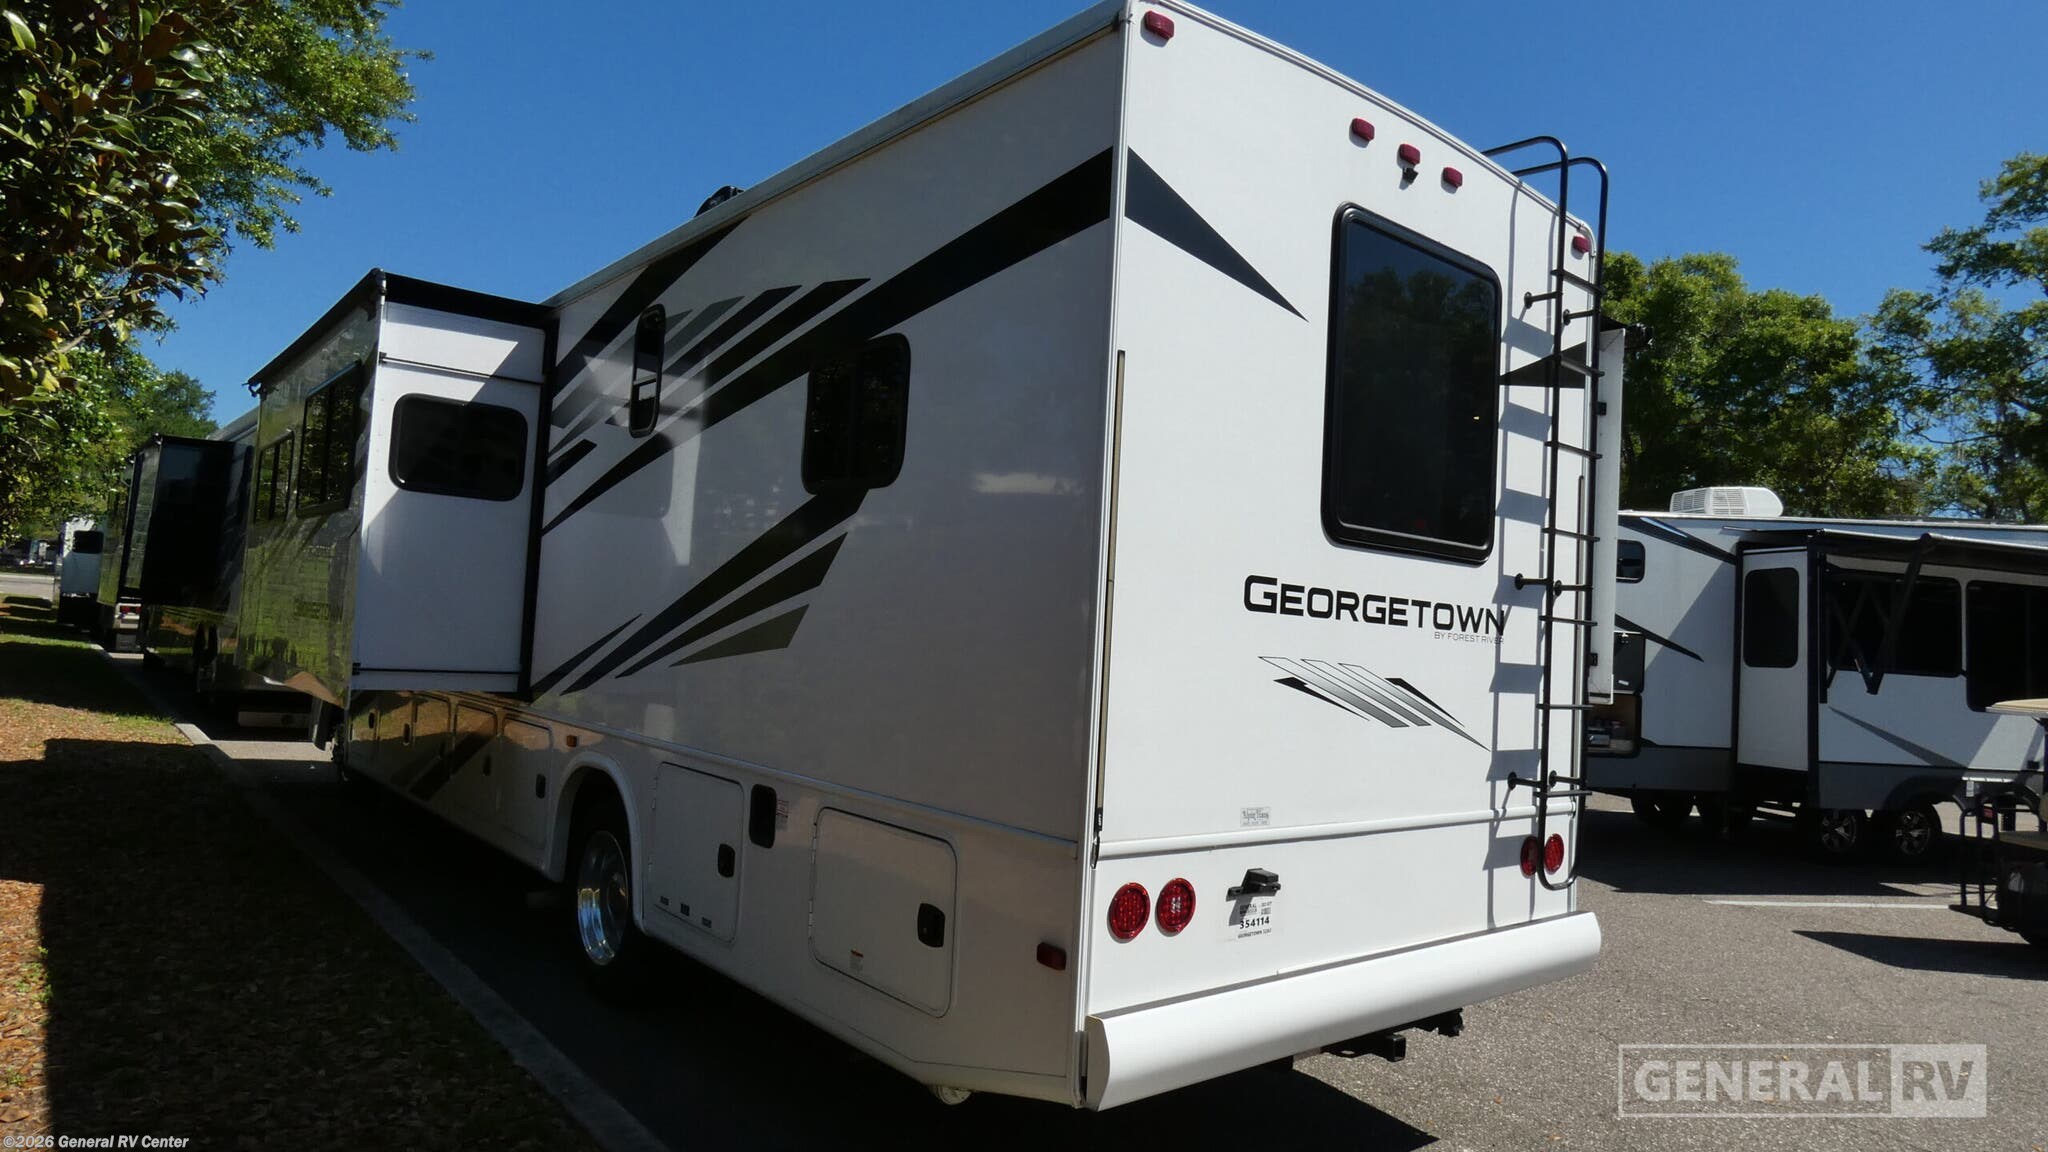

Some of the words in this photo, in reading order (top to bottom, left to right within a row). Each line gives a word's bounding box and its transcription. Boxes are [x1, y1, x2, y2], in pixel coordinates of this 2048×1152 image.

[1244, 575, 1504, 636] GEORGETOWN
[1434, 632, 1446, 640] BY
[1447, 633, 1480, 643] FOREST
[1481, 635, 1505, 645] RIVER
[1239, 915, 1270, 930] 354114
